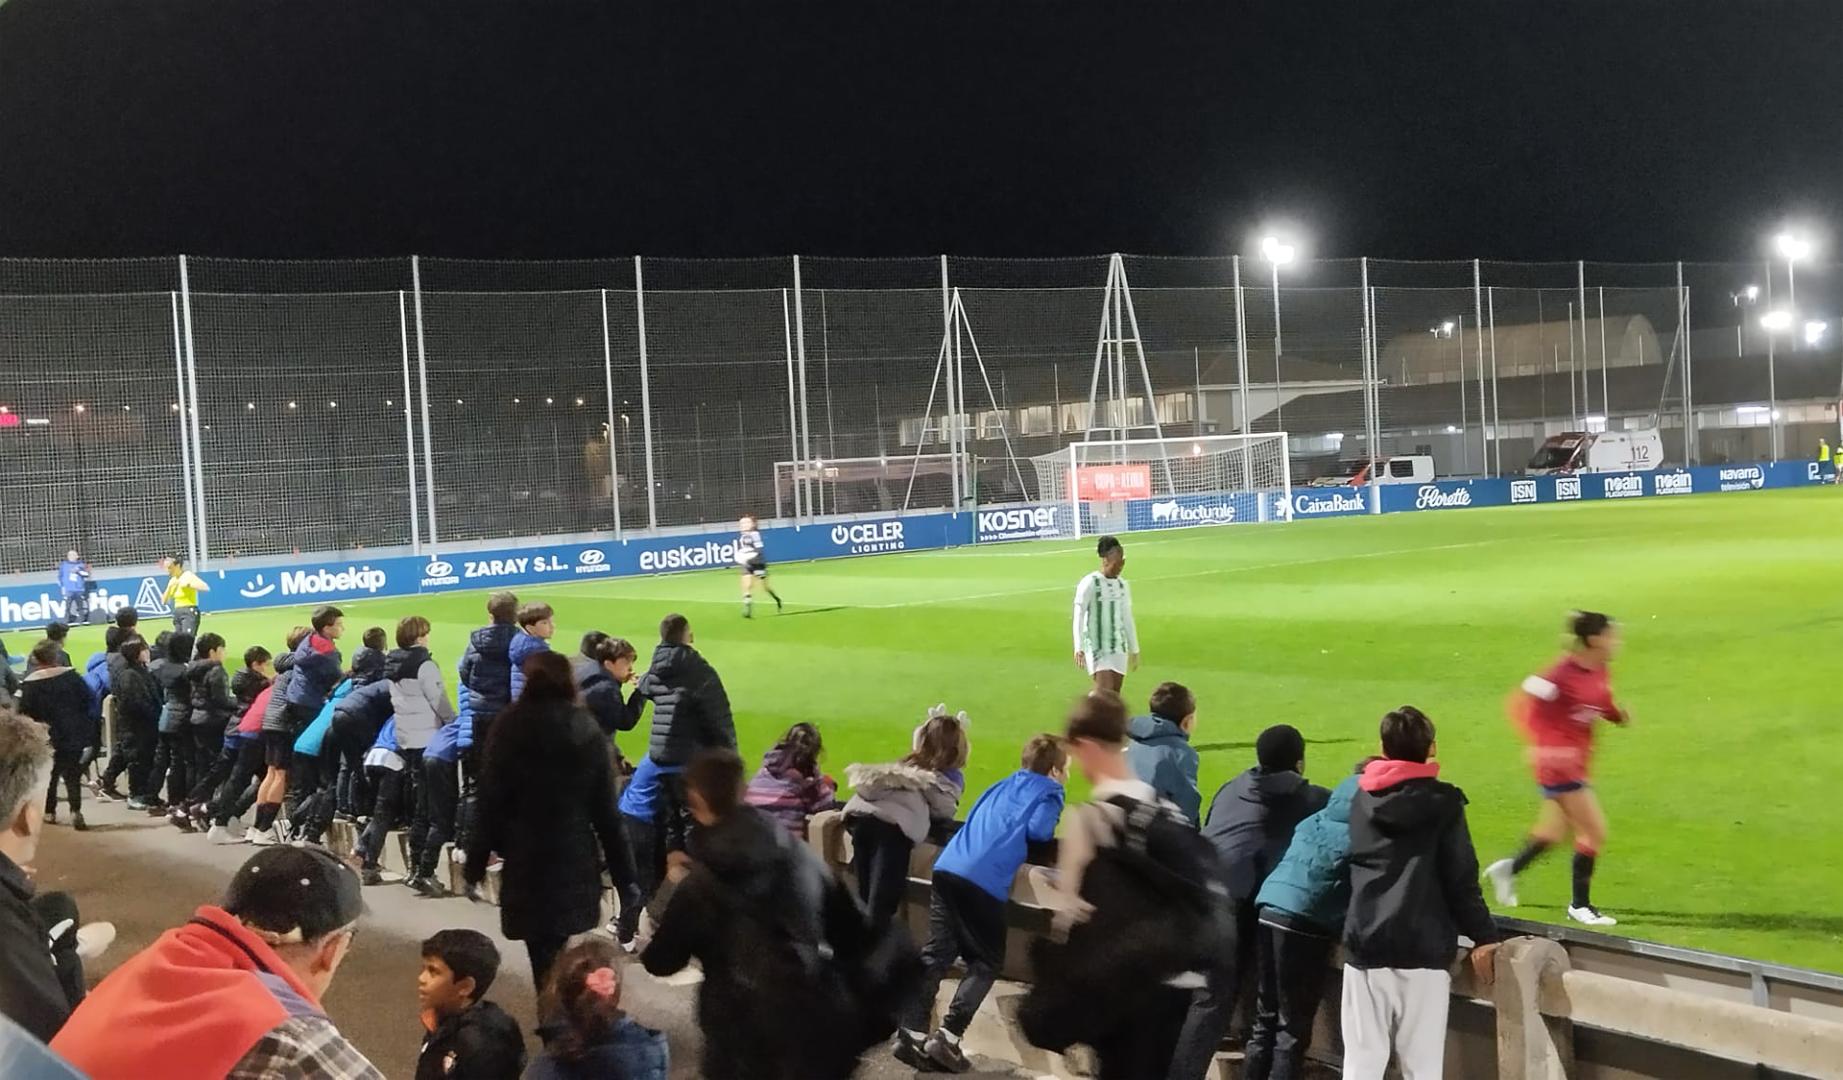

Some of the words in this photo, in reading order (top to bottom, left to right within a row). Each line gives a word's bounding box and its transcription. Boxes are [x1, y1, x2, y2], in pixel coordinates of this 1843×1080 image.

[1631, 445, 1648, 460] 112
[1416, 485, 1472, 509] Florette
[1514, 485, 1533, 499] ISN
[1559, 482, 1578, 495] ISN
[1295, 493, 1365, 513] CaixaBank
[849, 521, 904, 543] CELER
[640, 539, 740, 570] euskaltel
[852, 541, 905, 553] LIGHTING
[464, 558, 529, 577] ZARAY
[534, 555, 568, 572] S.L.
[281, 566, 386, 596] Mobekip
[0, 588, 129, 623] helvtia
